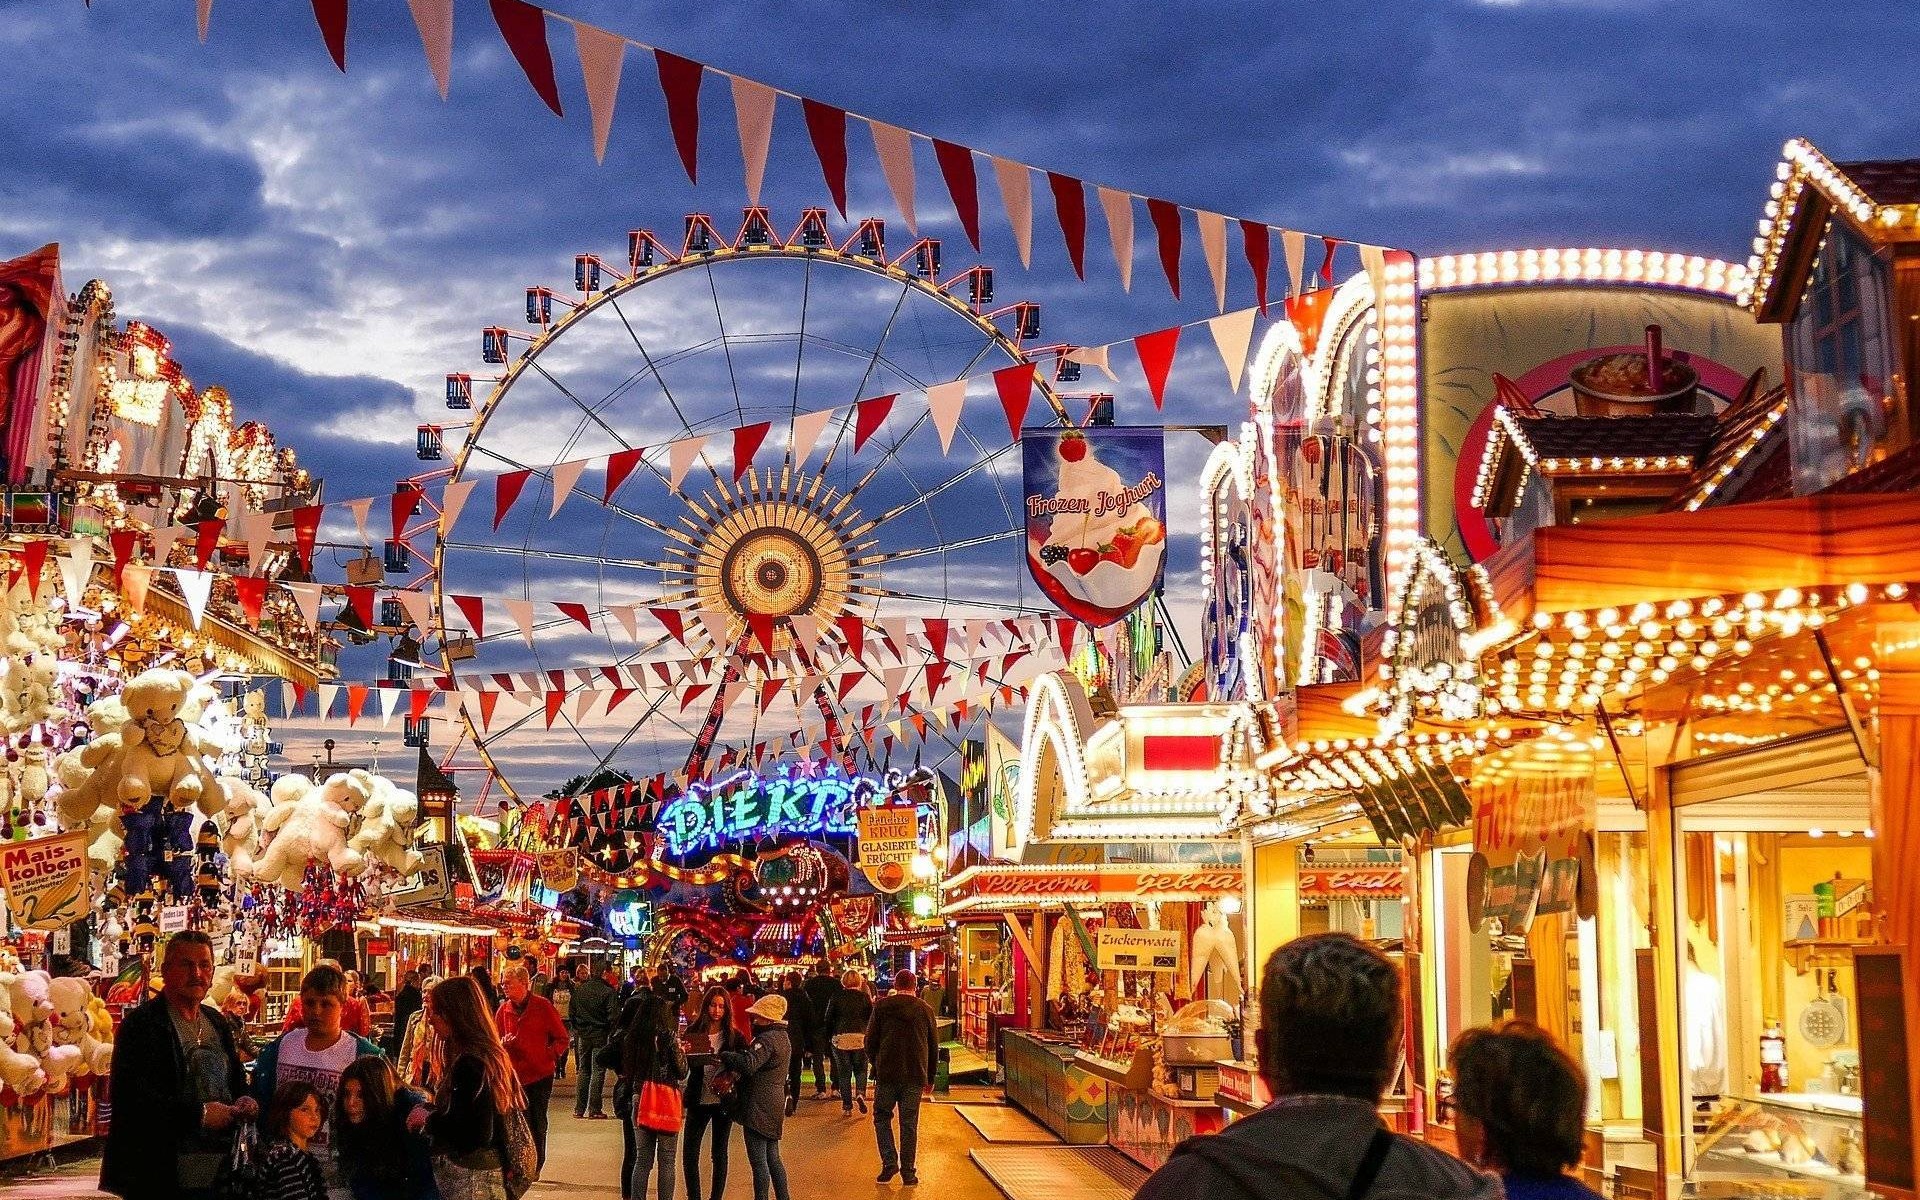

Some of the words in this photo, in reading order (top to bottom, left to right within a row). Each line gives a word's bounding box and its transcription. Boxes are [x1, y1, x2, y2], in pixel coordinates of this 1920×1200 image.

[1026, 494, 1091, 517] Frozen
[1094, 472, 1162, 518] Joghurt
[870, 826, 908, 839] KRUG
[861, 840, 917, 852] GLASIERTE
[4, 846, 73, 869] Mais-
[7, 857, 82, 882] kolben
[11, 883, 25, 891] mit
[26, 876, 49, 887] Butter
[50, 871, 69, 879] oder
[986, 873, 1093, 894] Popcorn
[1101, 933, 1177, 947] Zuckerwatte
